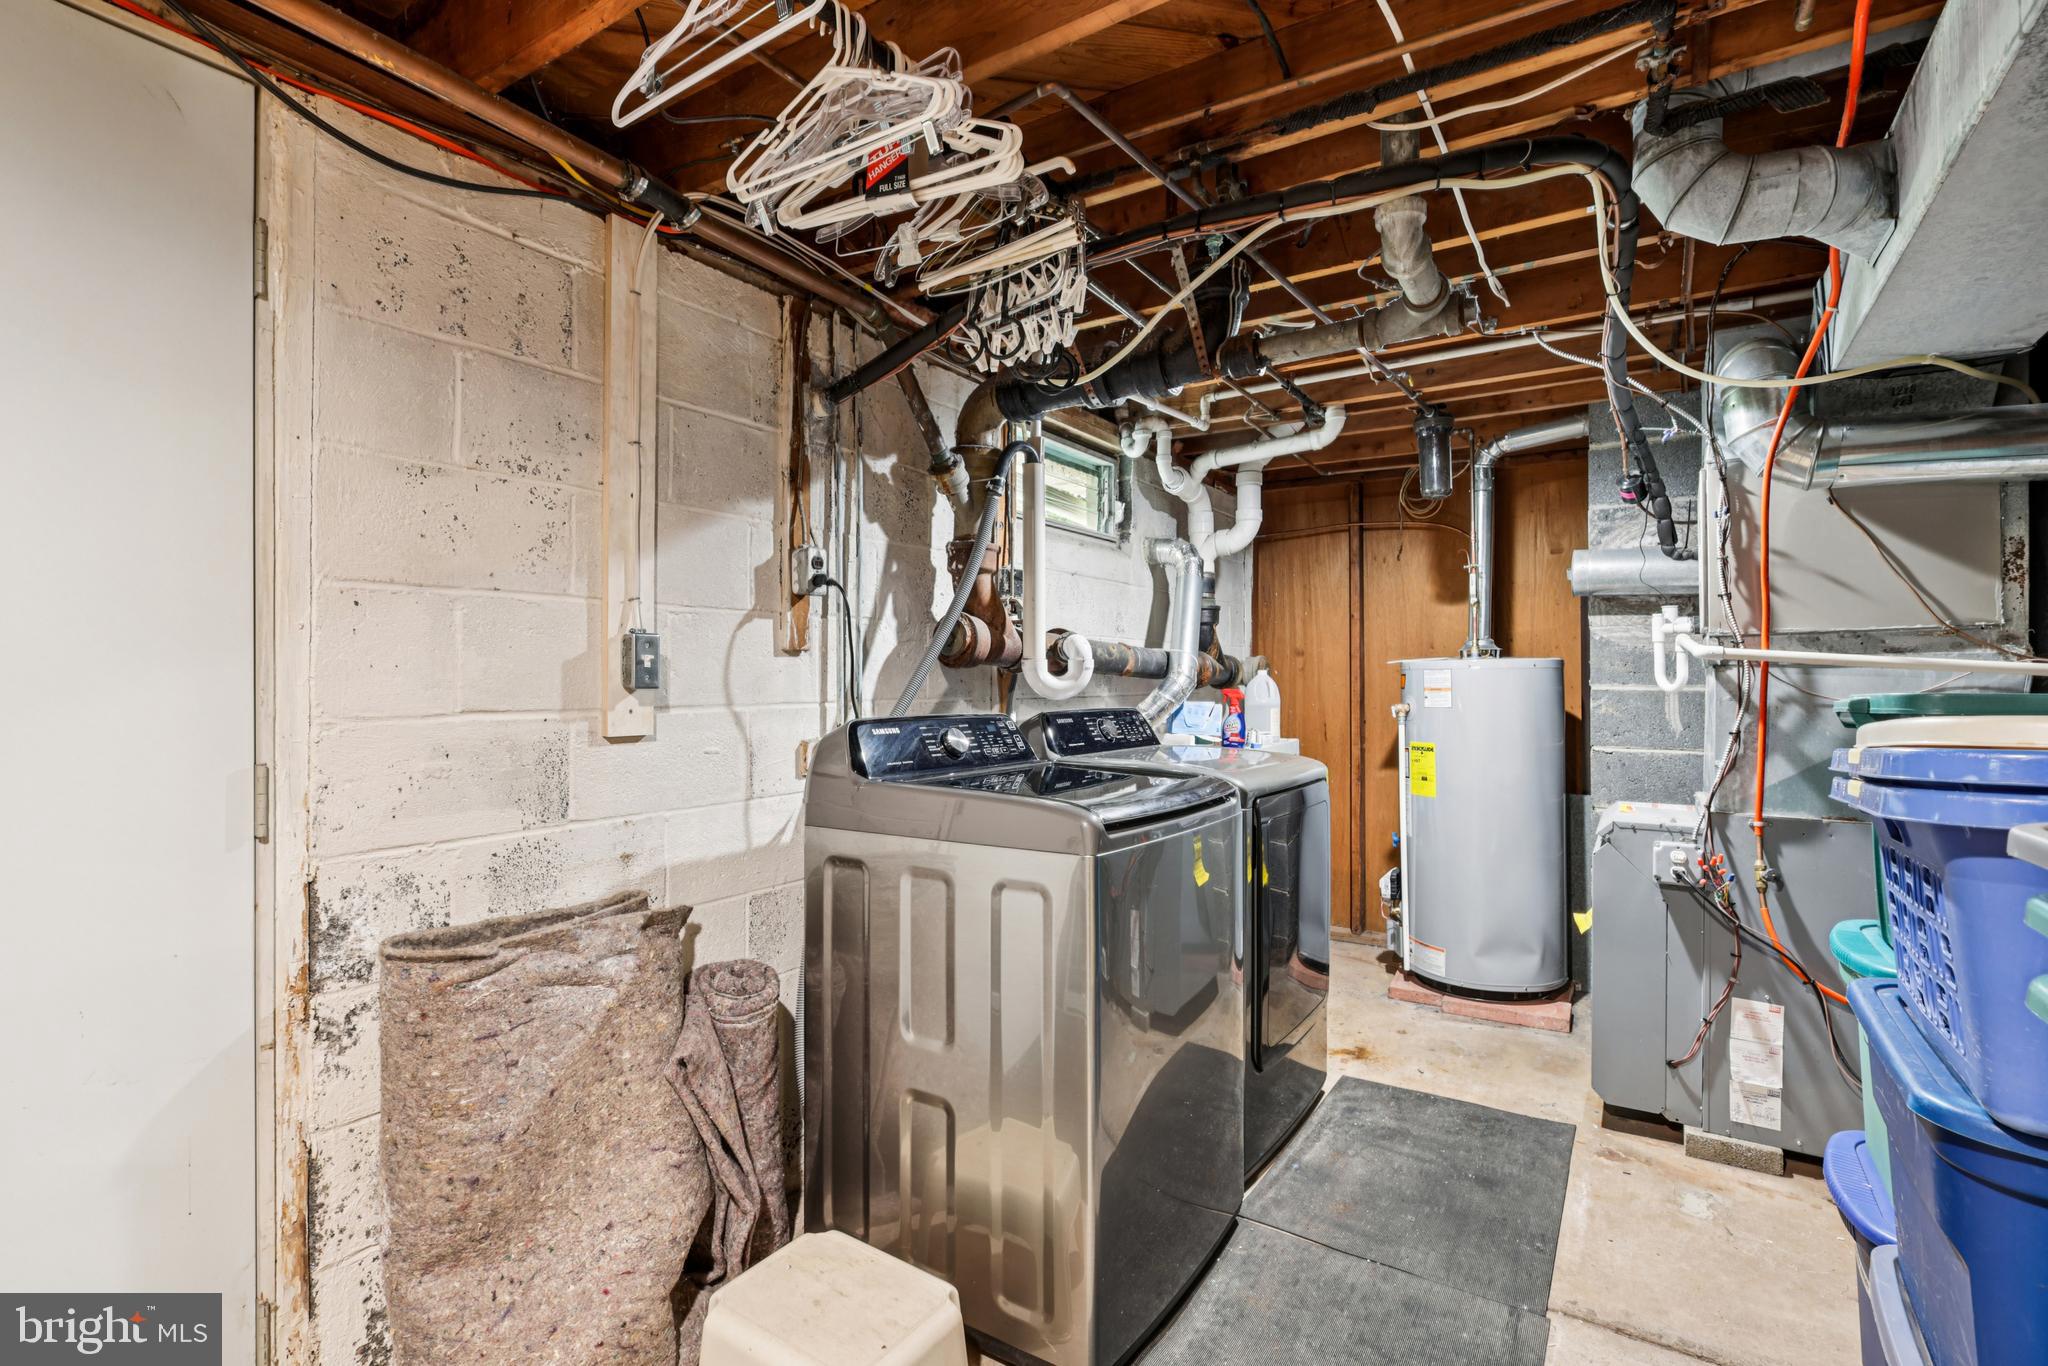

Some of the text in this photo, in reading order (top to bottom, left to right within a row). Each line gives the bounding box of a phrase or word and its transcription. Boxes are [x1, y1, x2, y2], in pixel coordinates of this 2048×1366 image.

[868, 149, 905, 181] HANGER
[879, 180, 906, 193] FULL SIZE
[871, 727, 900, 735] SAMSUNG
